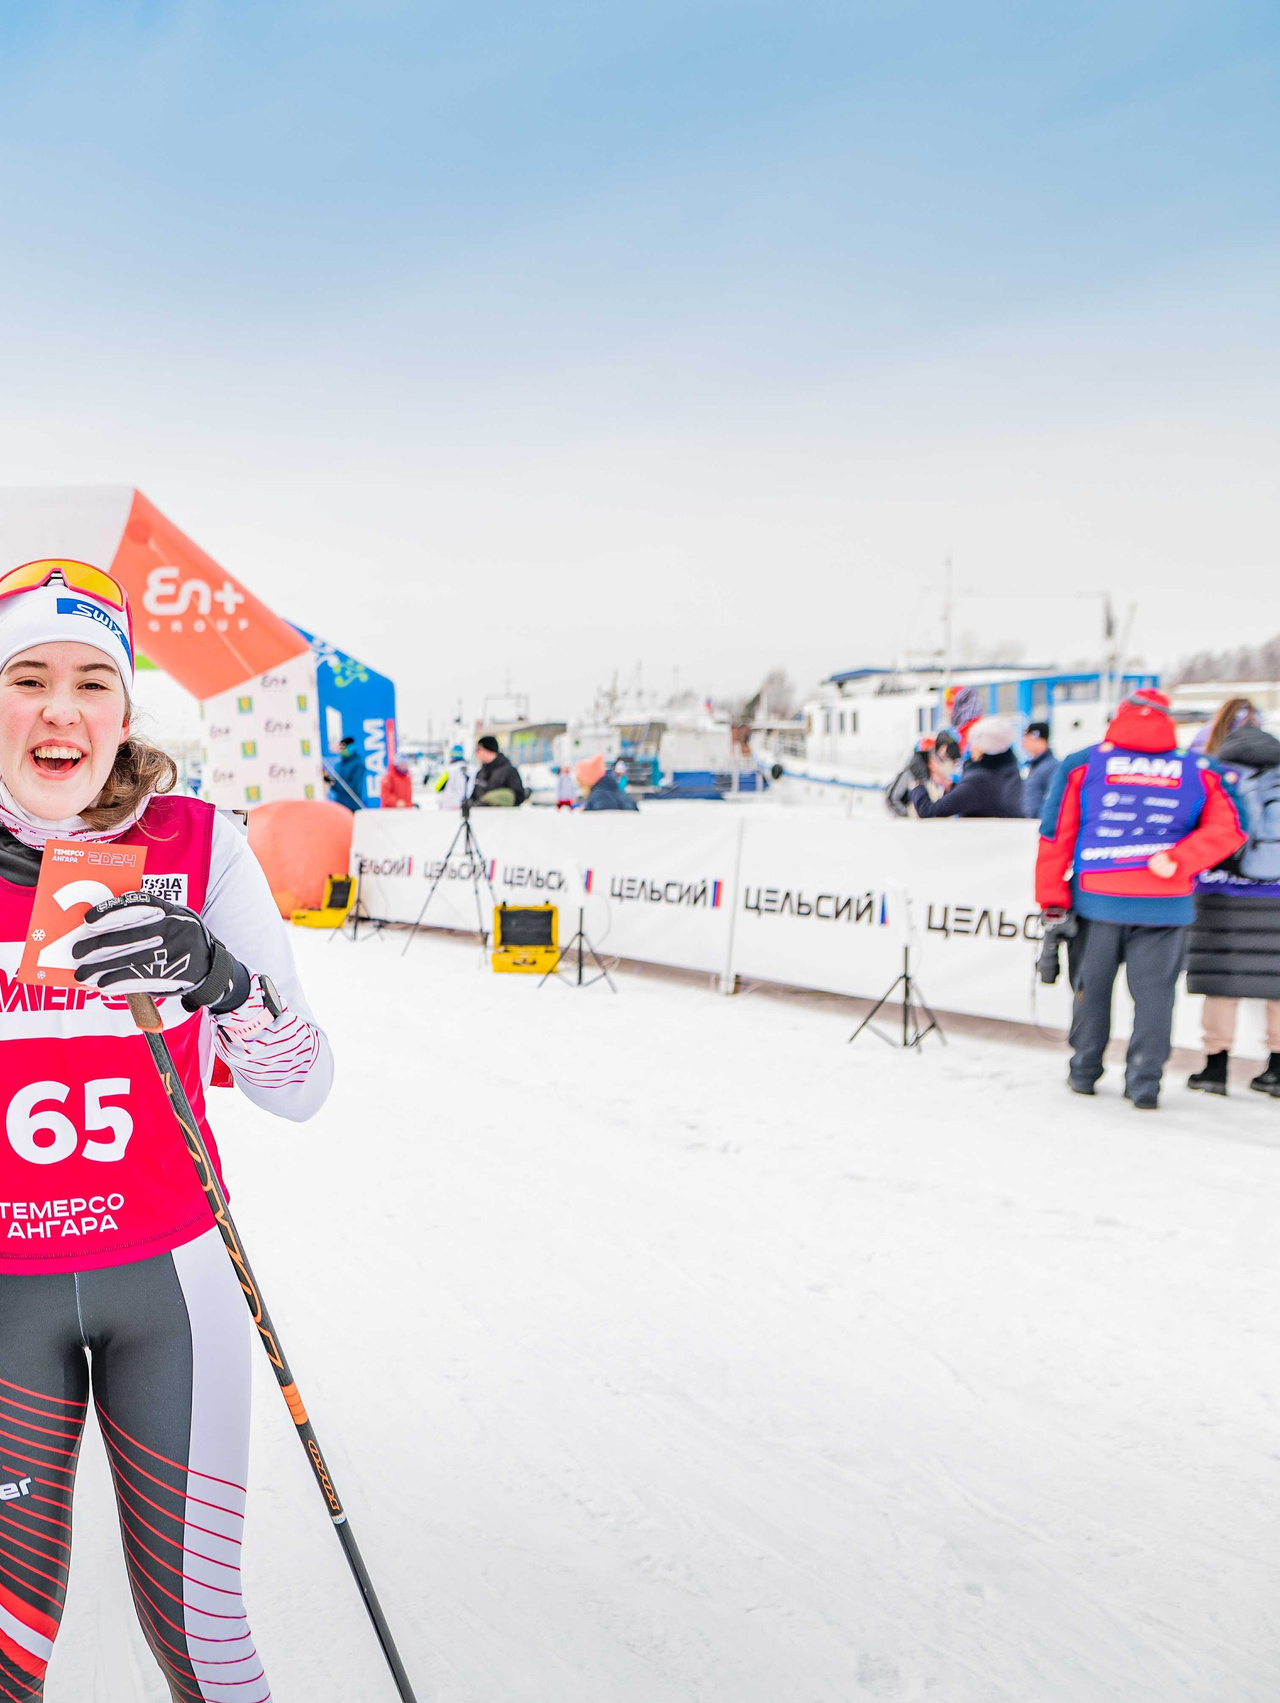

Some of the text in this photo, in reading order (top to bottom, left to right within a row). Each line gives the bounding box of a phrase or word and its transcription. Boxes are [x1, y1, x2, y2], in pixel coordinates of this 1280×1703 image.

[52, 855, 78, 863] АНГАРА
[53, 848, 84, 857] ТЕМЕРСО
[611, 876, 707, 908] ЦЕЛЬСИЙ
[745, 887, 875, 926] ЦЕЛЬСИЙ
[927, 904, 1045, 940] ЦЕЛЬС
[7, 1215, 119, 1239] АНГАРА
